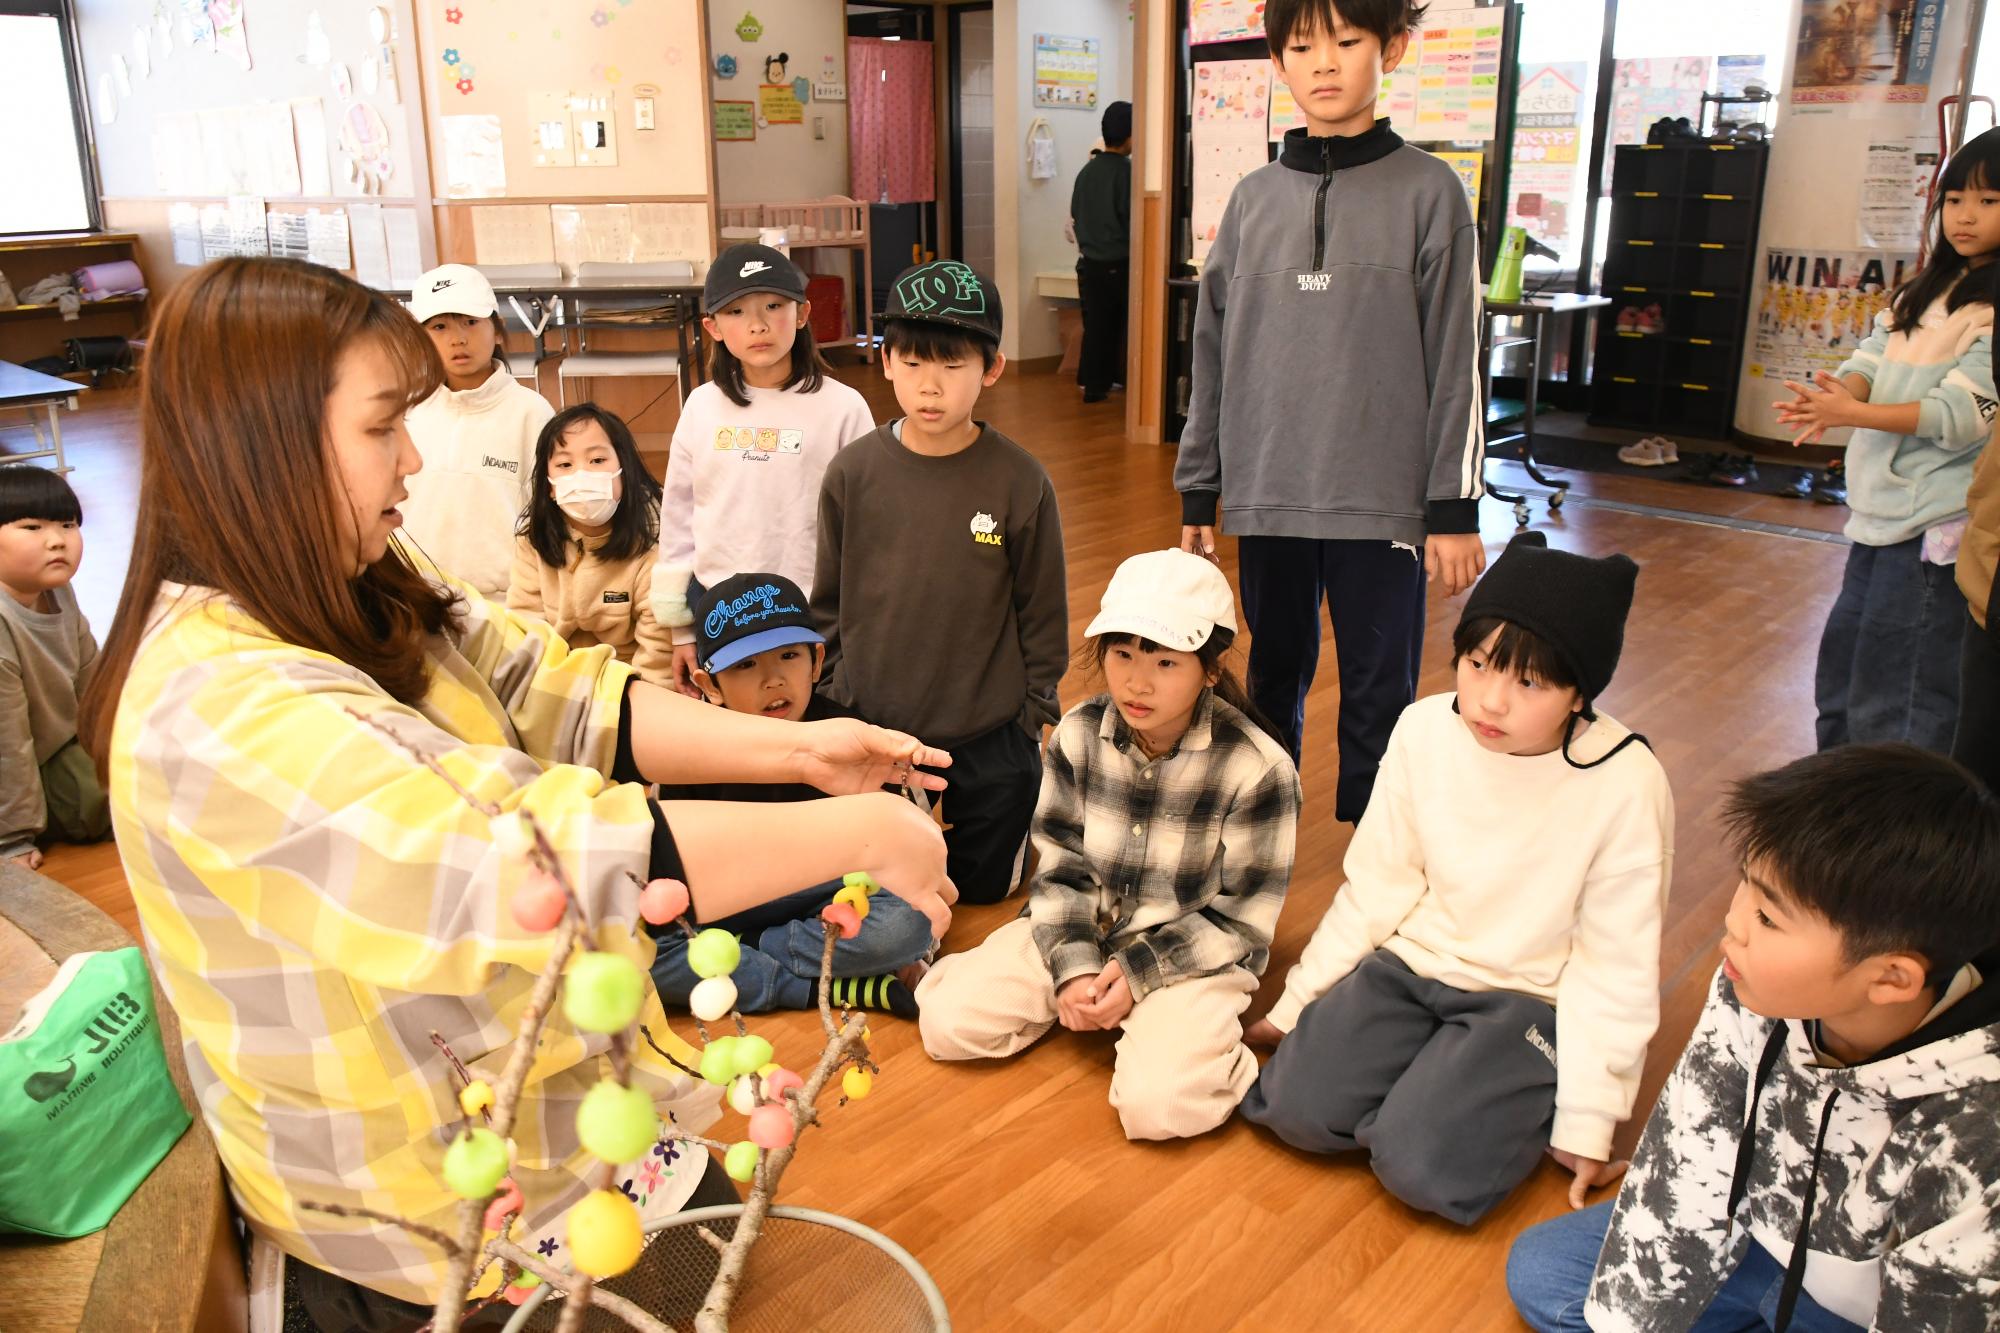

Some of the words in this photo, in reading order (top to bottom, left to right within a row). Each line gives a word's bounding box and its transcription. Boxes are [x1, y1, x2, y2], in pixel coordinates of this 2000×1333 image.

[743, 260, 765, 270] NIKE
[1768, 254, 1842, 288] WIN
[1297, 273, 1332, 284] HEAVY
[1300, 281, 1329, 290] DUTY
[482, 454, 519, 474] UNDAUNTED
[975, 531, 1003, 546] MAX
[704, 584, 781, 638] Change
[734, 613, 760, 626] before
[759, 608, 776, 620] you
[84, 992, 141, 1054] JIB
[45, 1072, 97, 1121] MARINE
[101, 1014, 151, 1069] BOUTIQUE
